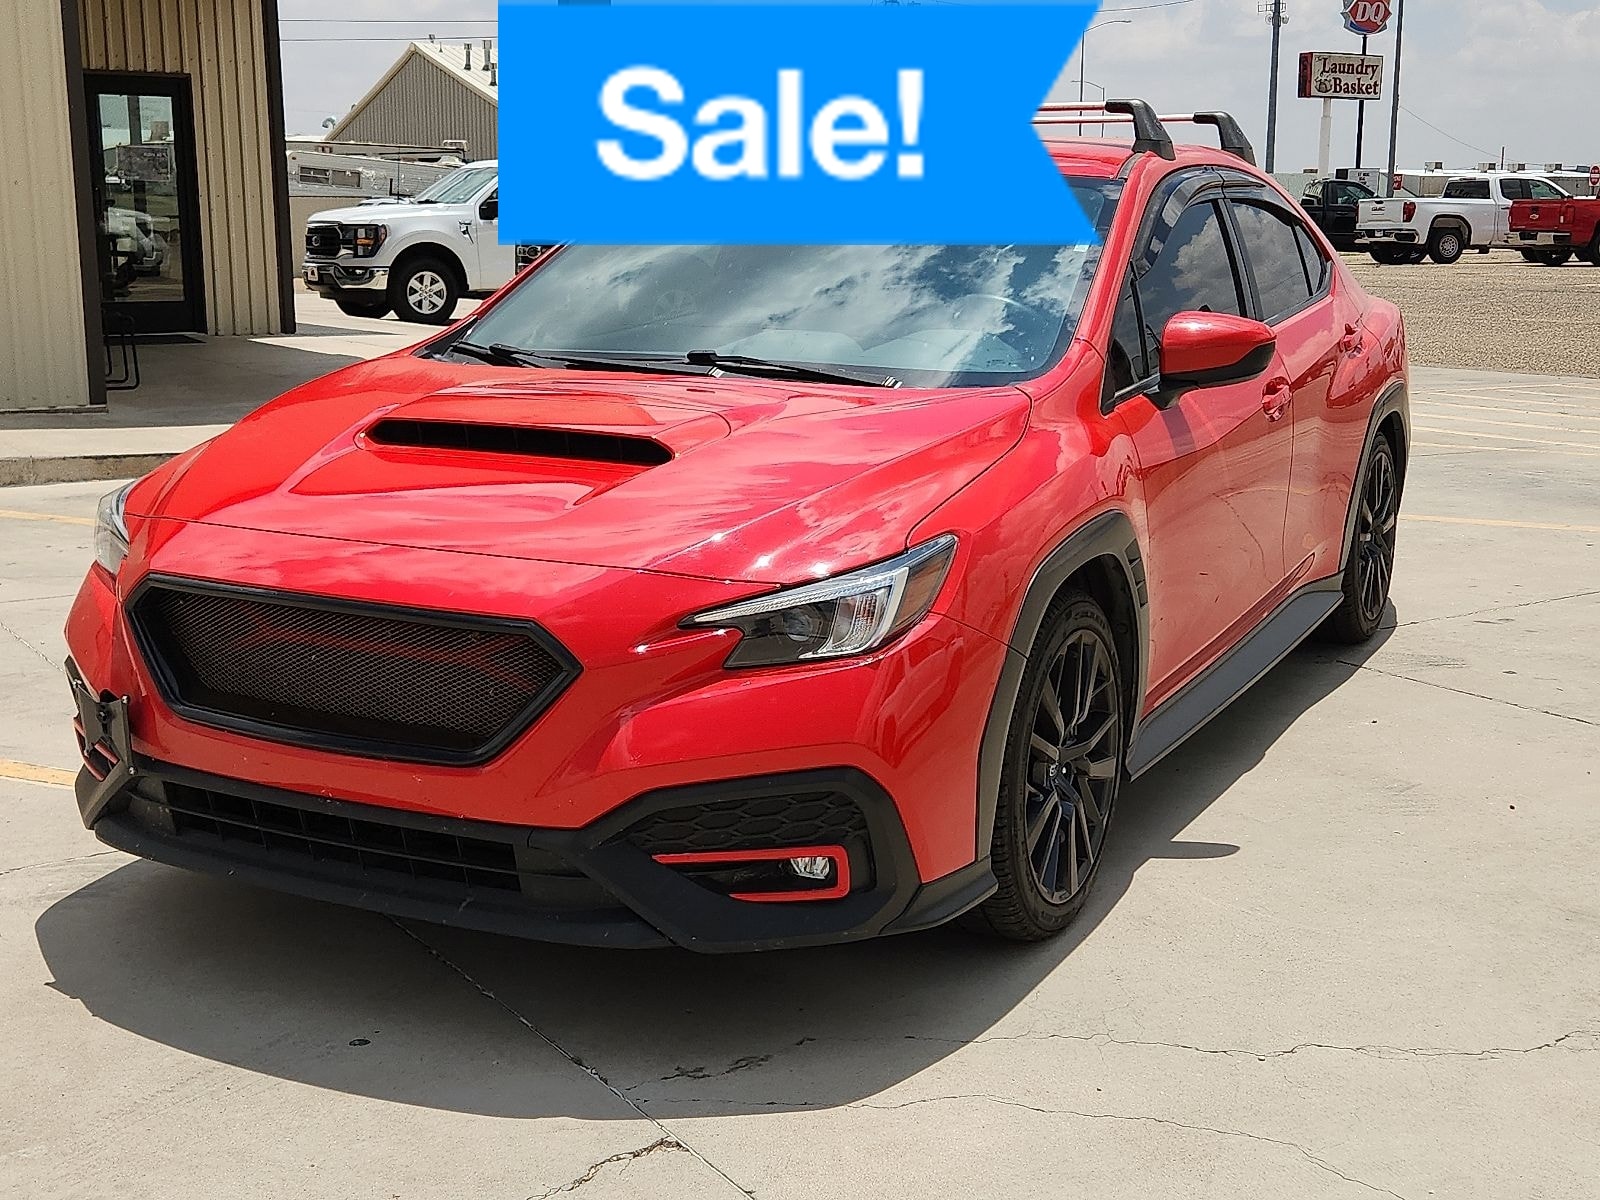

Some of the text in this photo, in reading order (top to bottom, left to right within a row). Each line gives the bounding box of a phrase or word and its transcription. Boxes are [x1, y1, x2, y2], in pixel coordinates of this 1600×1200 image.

[1355, 1, 1385, 25] DQ
[1322, 57, 1379, 80] Laundry
[1332, 77, 1379, 95] Basket
